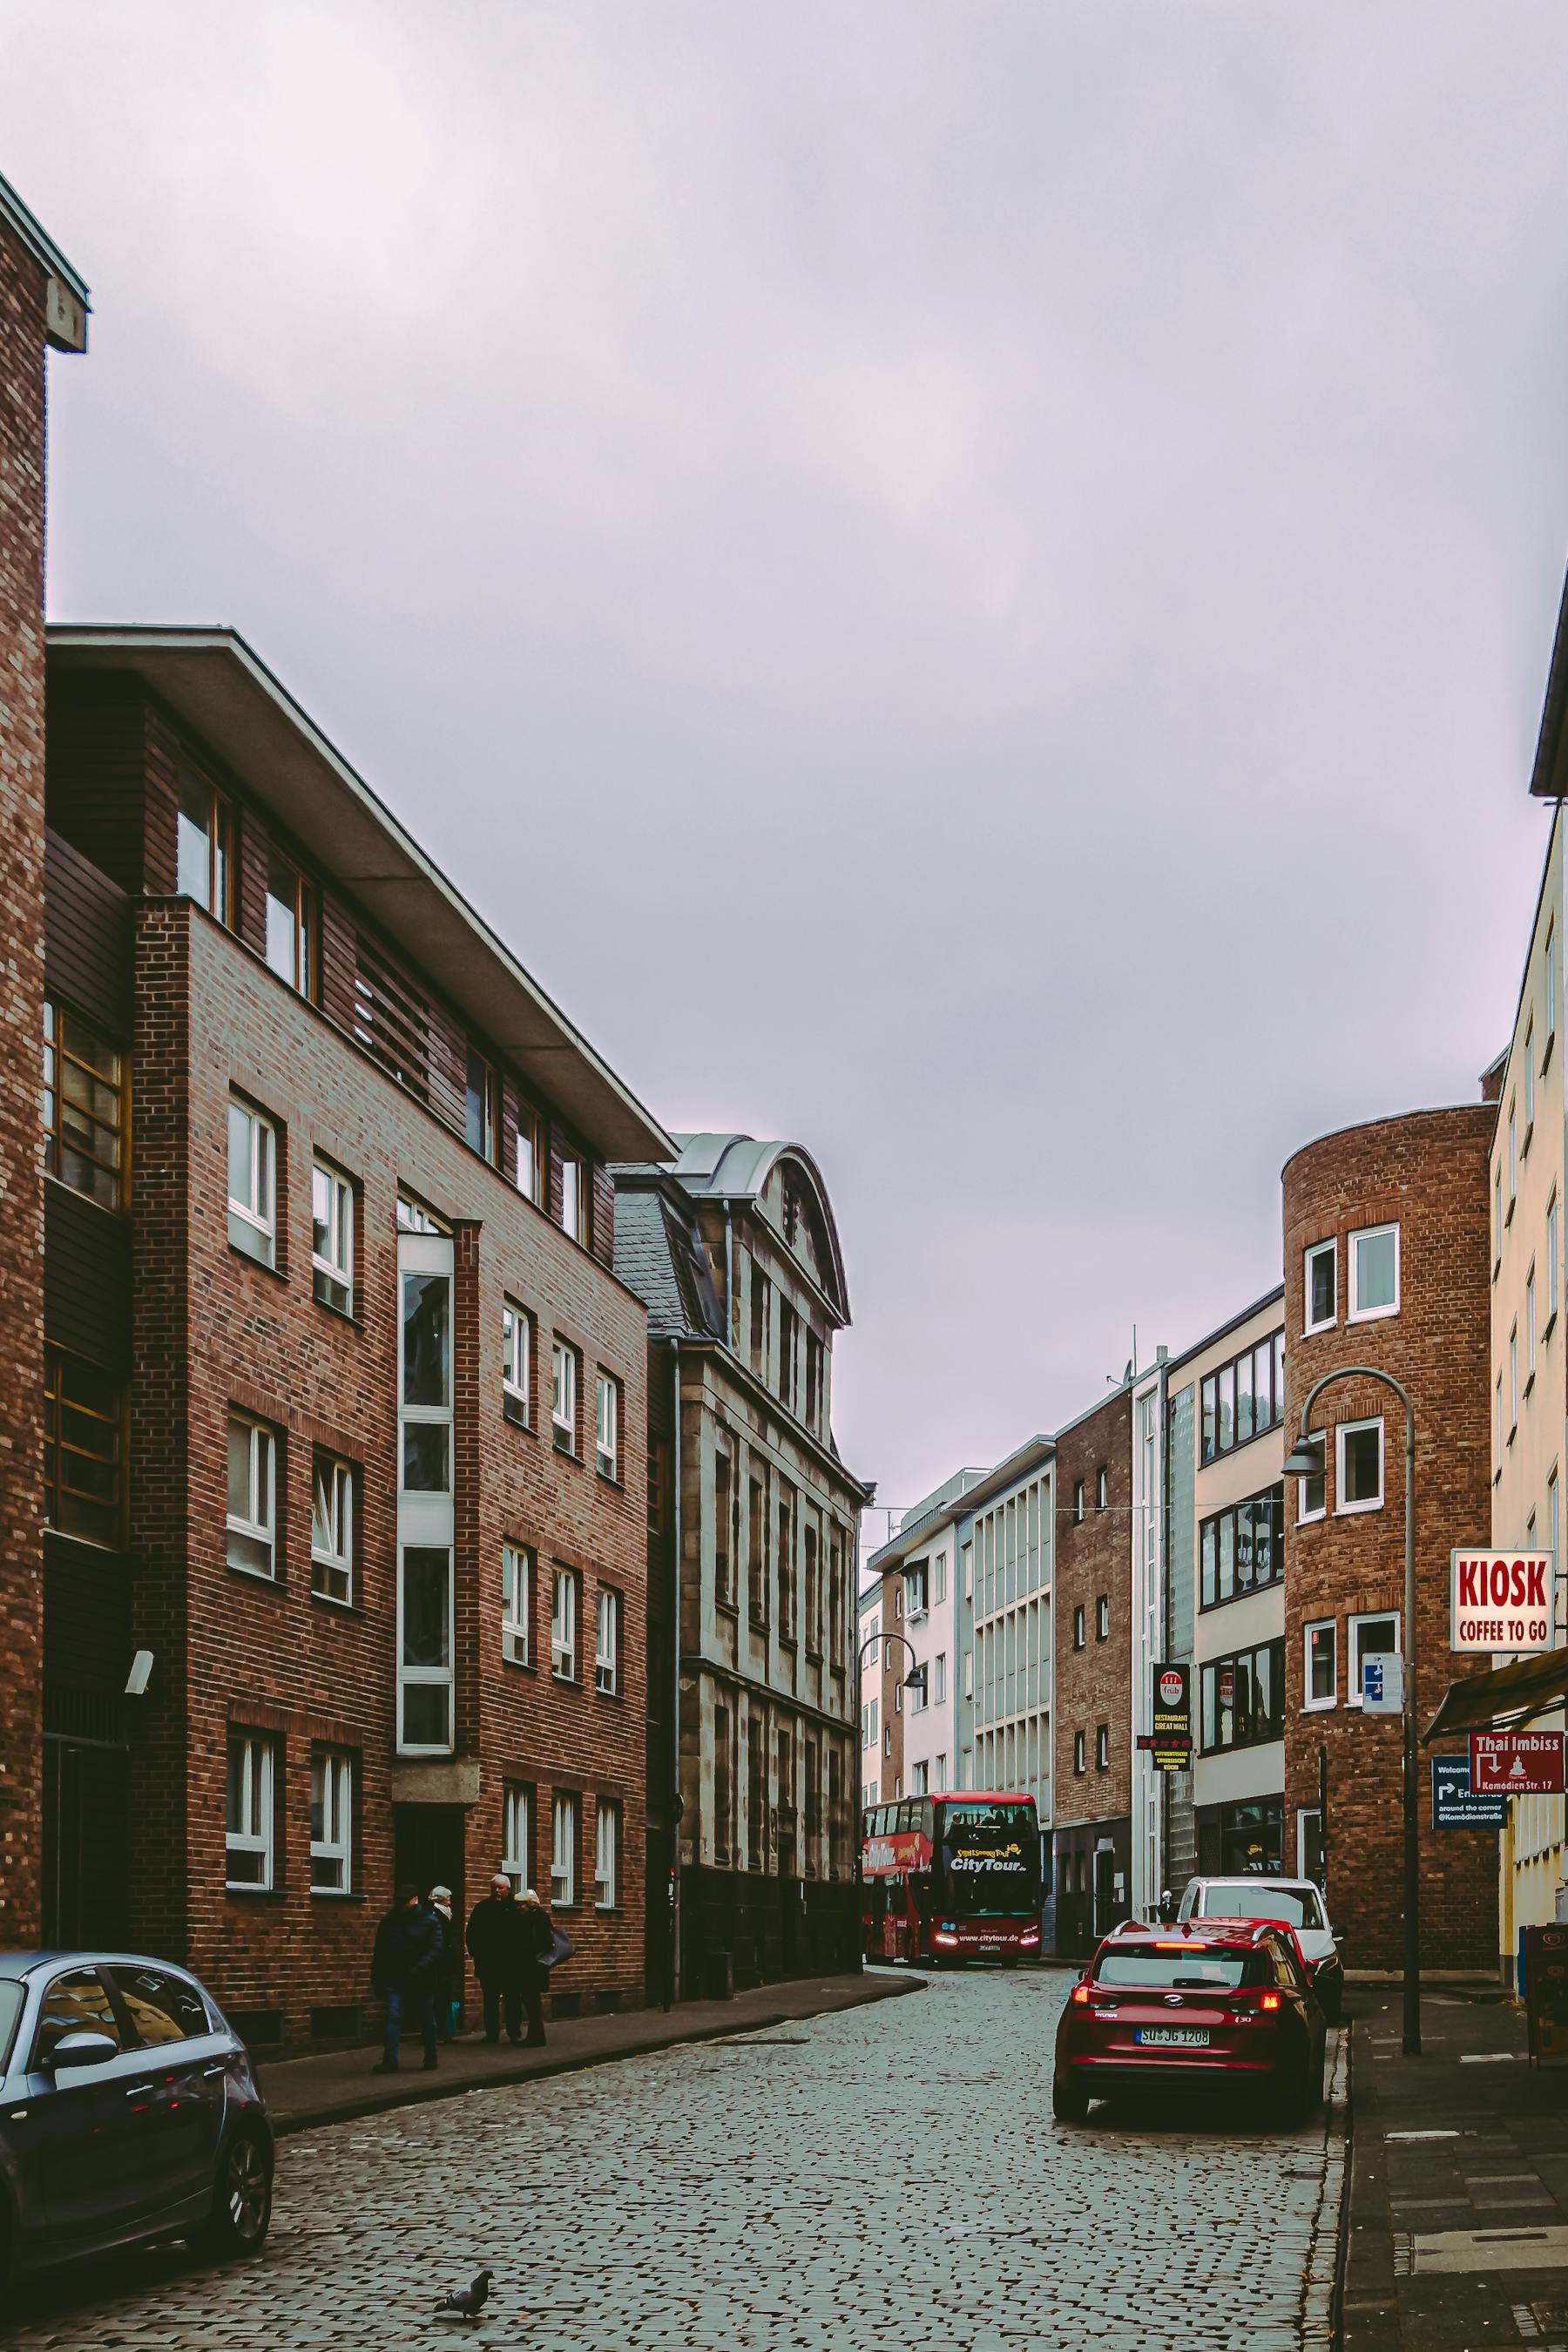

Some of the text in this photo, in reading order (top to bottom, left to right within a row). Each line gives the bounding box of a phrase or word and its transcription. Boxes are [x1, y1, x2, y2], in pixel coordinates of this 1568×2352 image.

[1459, 1560, 1547, 1607] KIOSK
[1459, 1620, 1547, 1641] COFFEE TO GO
[1477, 1735, 1559, 1752] Thai Imbiss
[1526, 1781, 1540, 1790] Str.
[1543, 1781, 1552, 1789] 17
[959, 1934, 1019, 1943] www.citytour.de
[1142, 2030, 1156, 2041] SU
[1181, 2030, 1210, 2043] 1208
